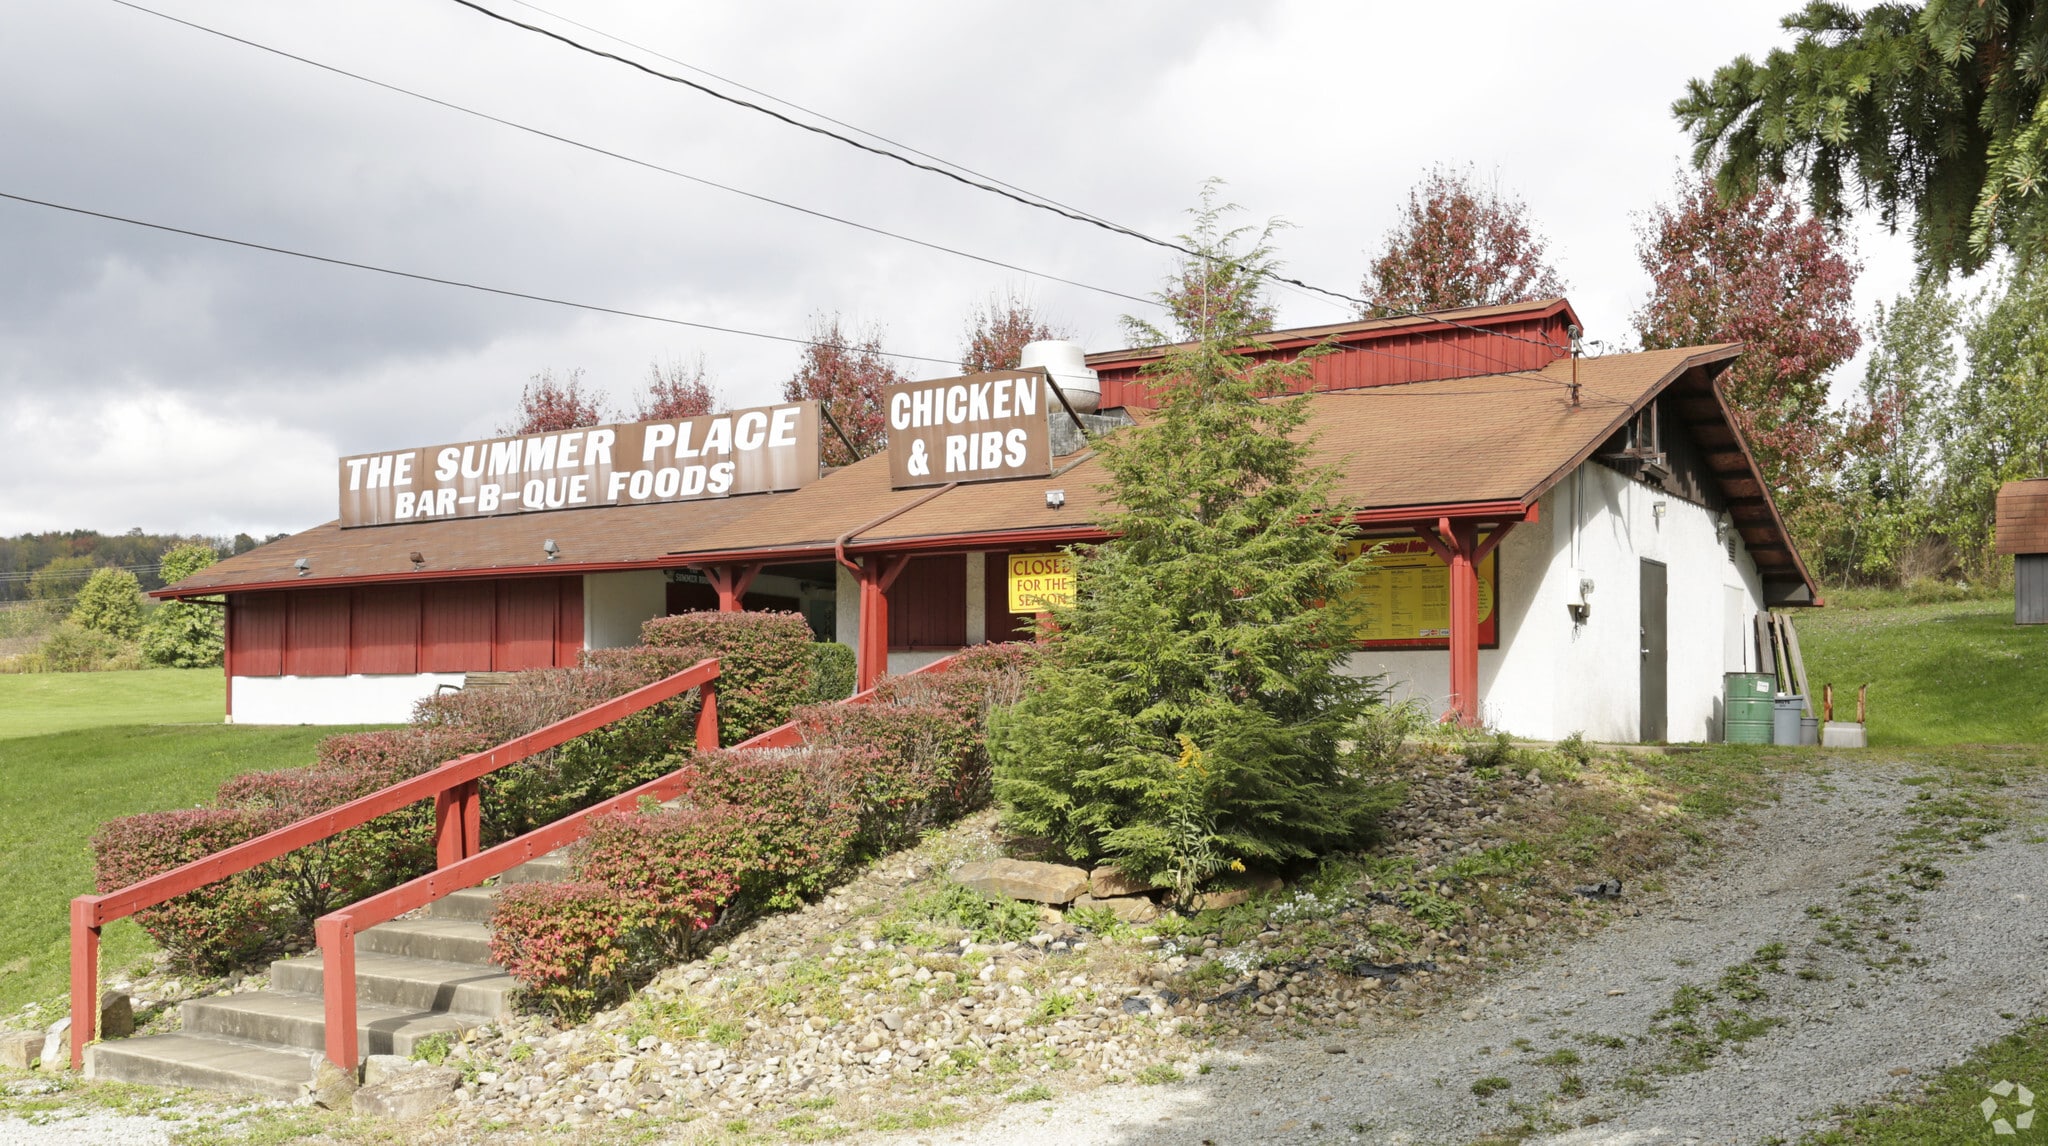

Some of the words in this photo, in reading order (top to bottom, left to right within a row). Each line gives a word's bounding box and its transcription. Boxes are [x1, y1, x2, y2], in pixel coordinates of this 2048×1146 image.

[890, 376, 1037, 430] CHICKEN
[347, 452, 415, 491] THE
[435, 429, 615, 482] SUMMER
[642, 406, 801, 462] PLACE
[907, 438, 930, 477] &
[945, 428, 1027, 473] RIBS
[395, 474, 589, 519] BAR-B-QUE
[607, 461, 736, 500] FOODS
[1017, 580, 1041, 592] FOR
[1045, 578, 1067, 591] THE
